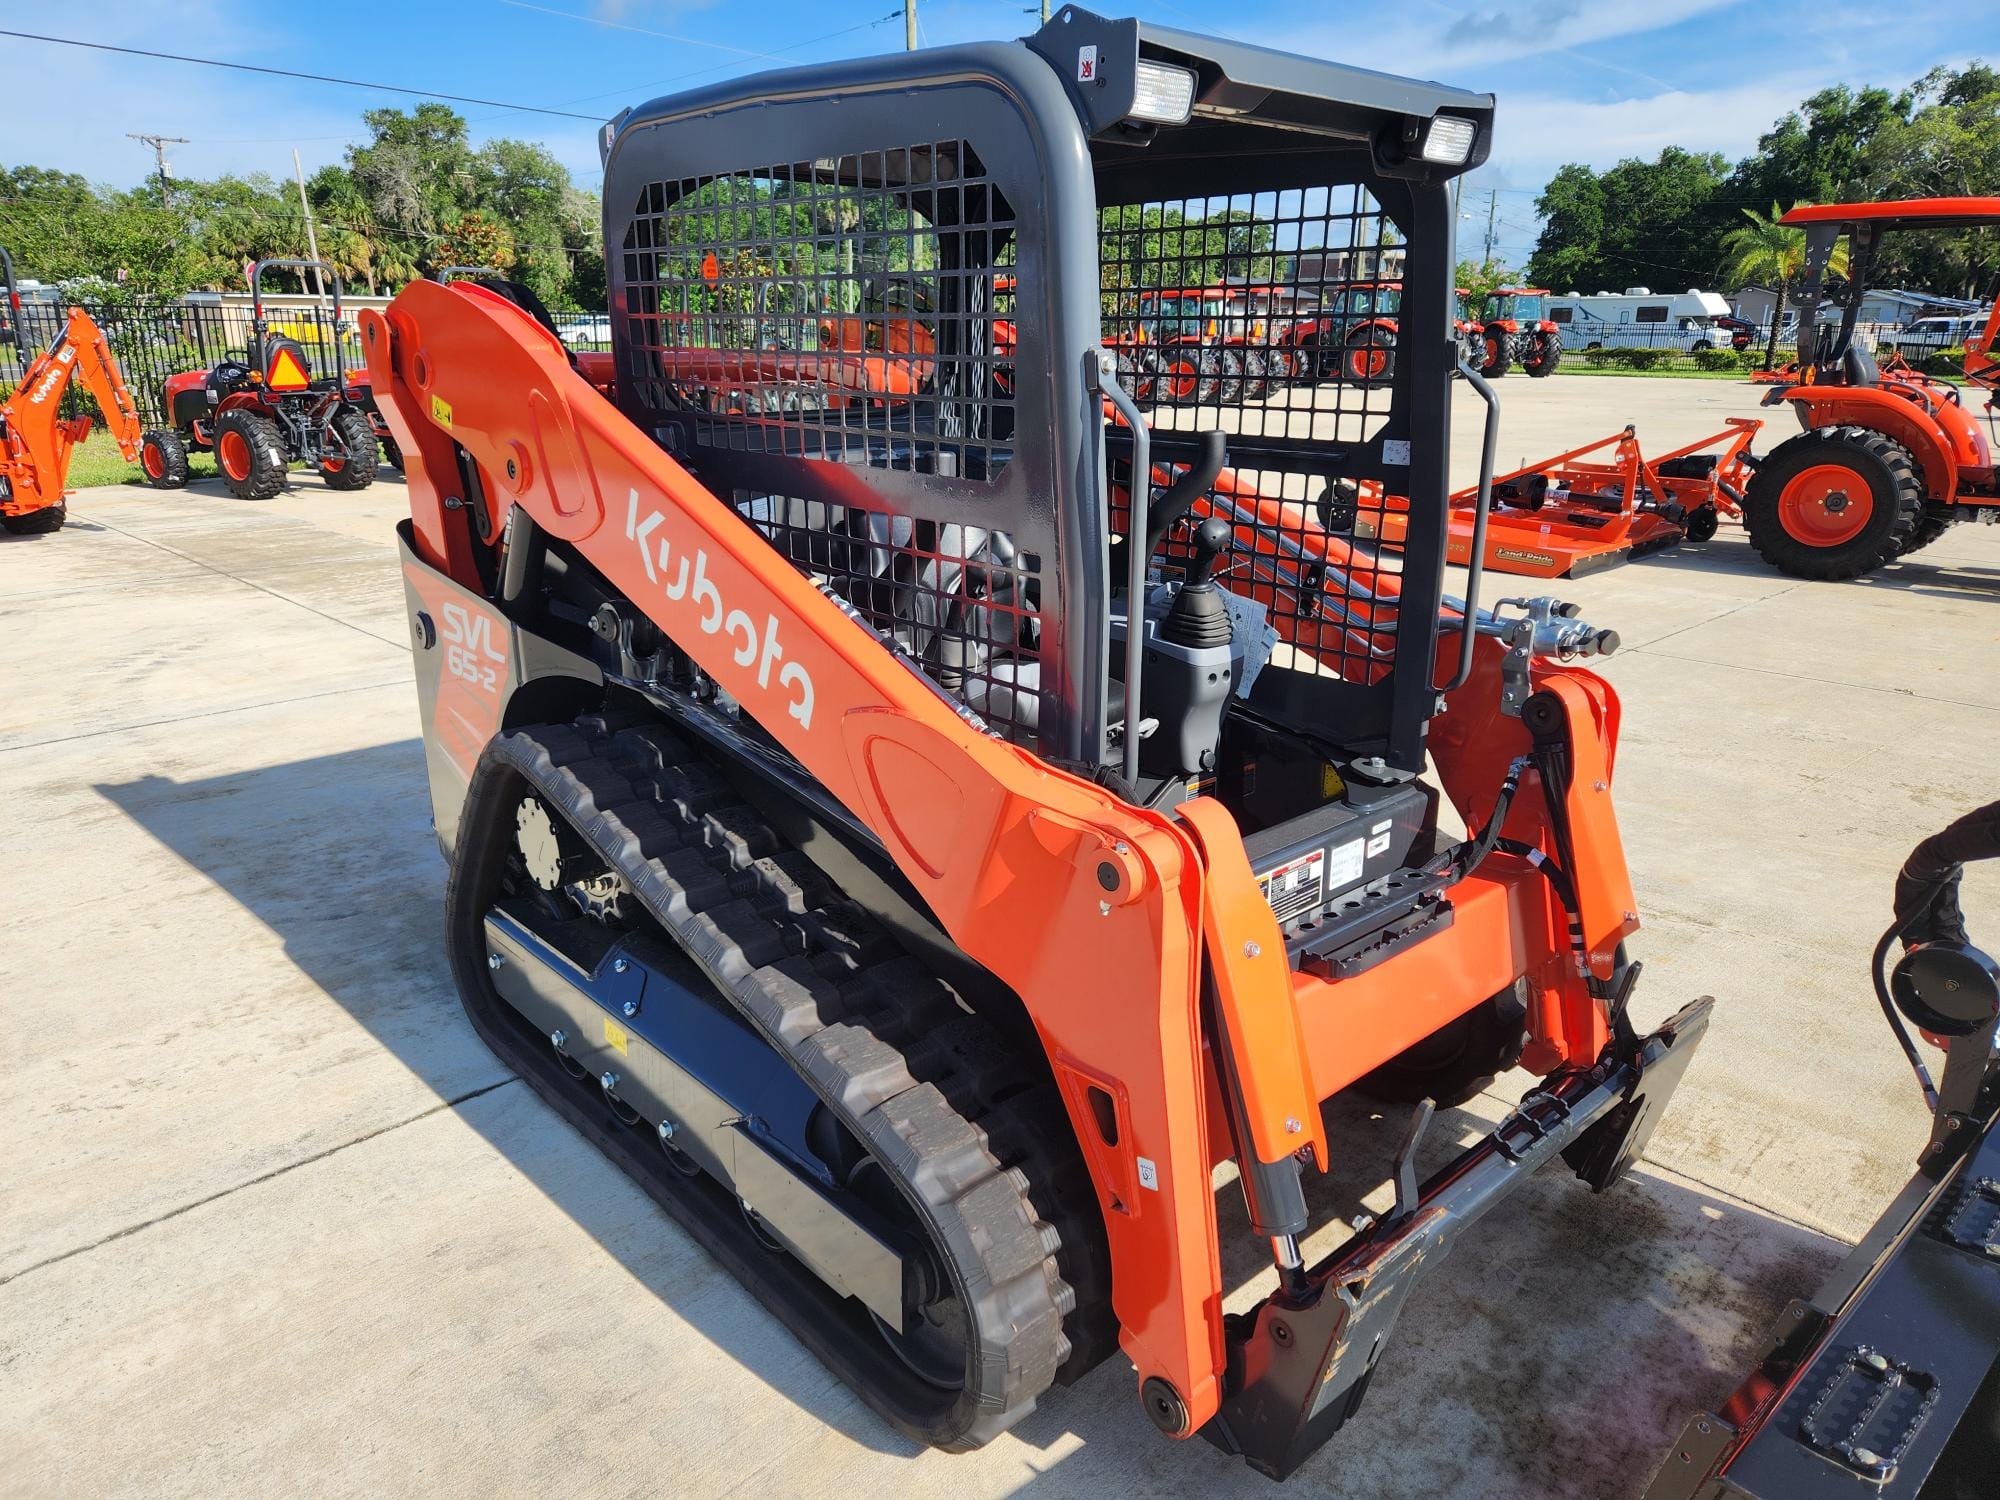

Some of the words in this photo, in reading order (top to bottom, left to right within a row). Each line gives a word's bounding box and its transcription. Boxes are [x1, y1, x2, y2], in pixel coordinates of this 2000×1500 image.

[31, 369, 62, 404] Kubota
[442, 602, 506, 664] SVL
[625, 487, 815, 731] Kubota
[448, 645, 497, 693] 65-2
